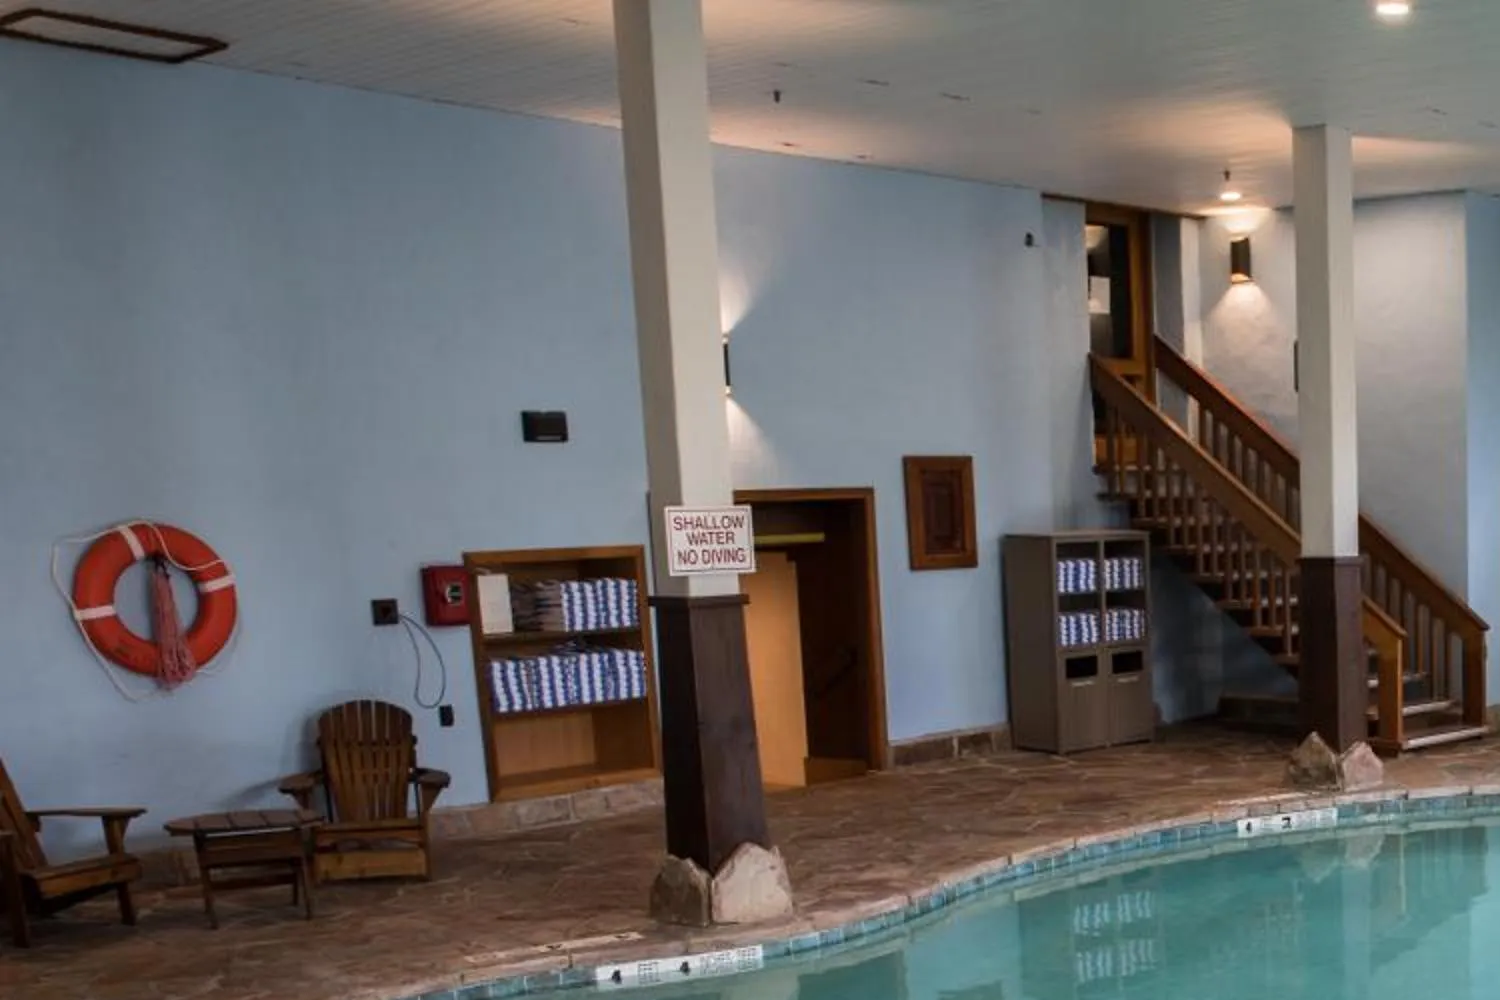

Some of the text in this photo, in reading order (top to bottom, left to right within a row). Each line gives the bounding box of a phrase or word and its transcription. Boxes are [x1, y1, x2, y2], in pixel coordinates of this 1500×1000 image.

[673, 515, 745, 531] SHALLOW
[686, 531, 735, 546] WATER
[677, 548, 746, 566] NO DIVING
